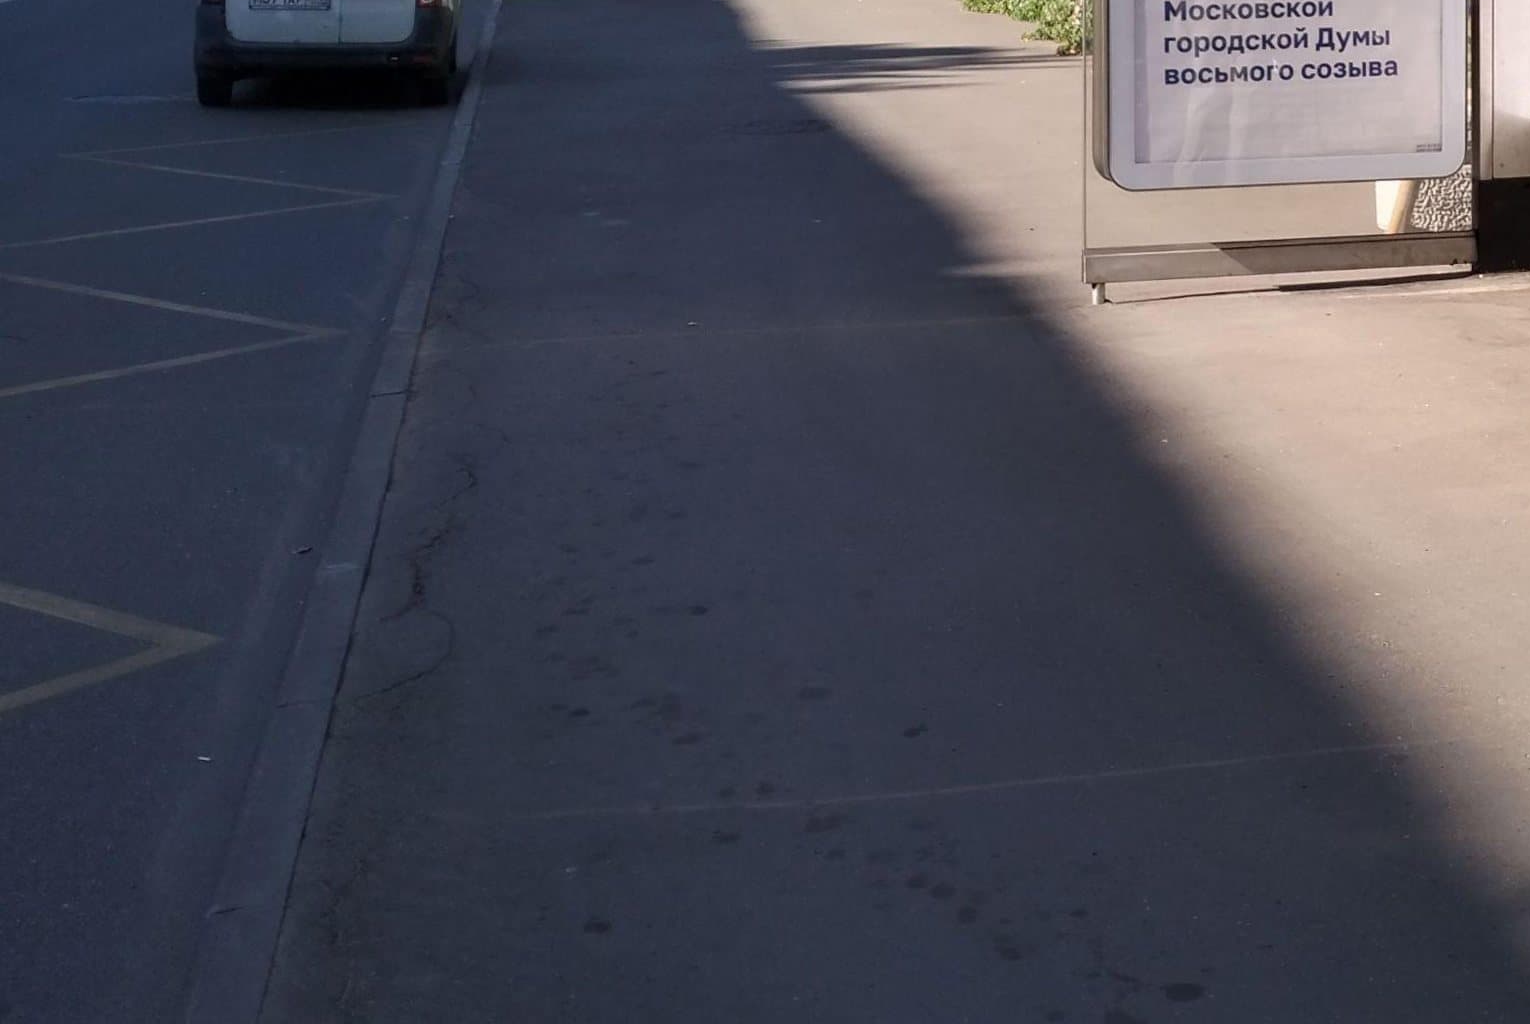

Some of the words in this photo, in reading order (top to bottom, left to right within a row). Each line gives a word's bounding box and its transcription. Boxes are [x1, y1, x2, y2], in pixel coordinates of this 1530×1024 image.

[1163, 27, 1309, 58] городской
[1315, 26, 1391, 53] Думы
[1164, 62, 1295, 85] восьмого
[1300, 59, 1399, 80] созыва
